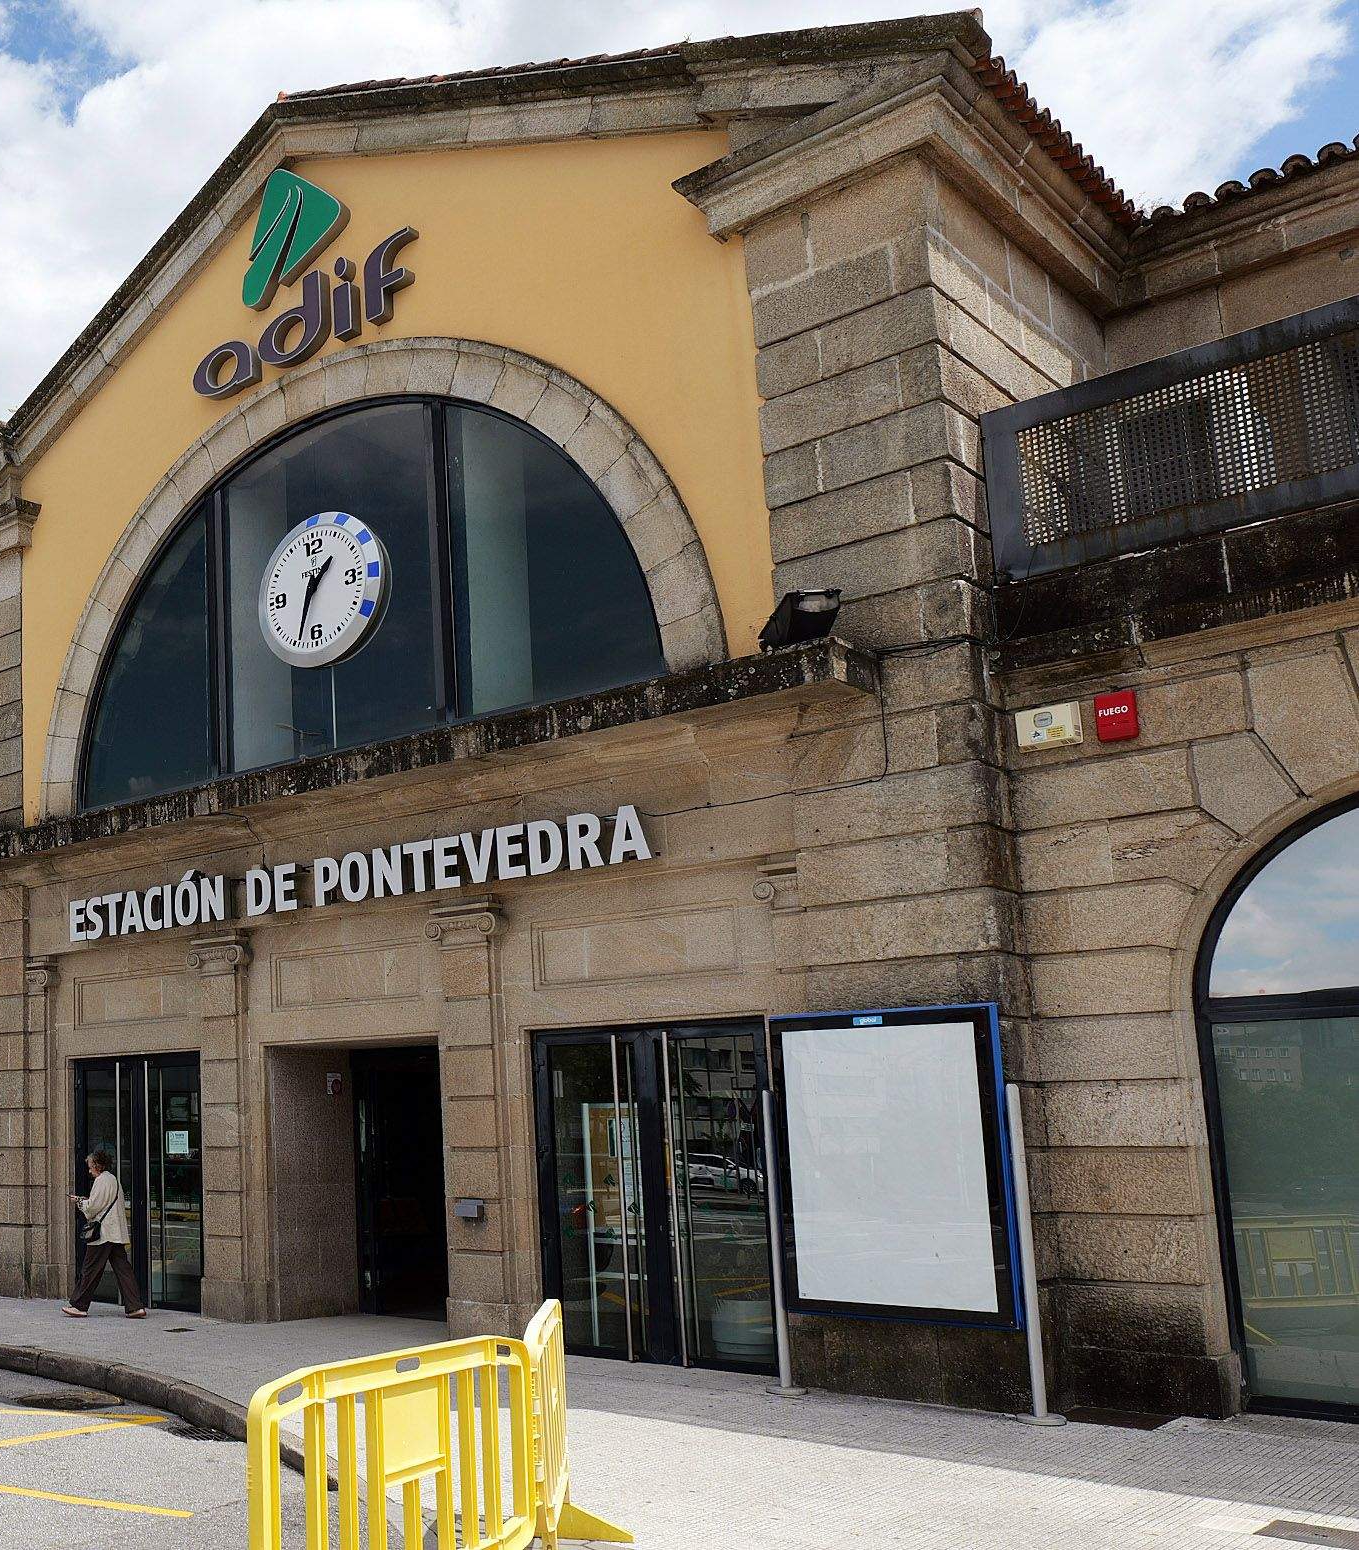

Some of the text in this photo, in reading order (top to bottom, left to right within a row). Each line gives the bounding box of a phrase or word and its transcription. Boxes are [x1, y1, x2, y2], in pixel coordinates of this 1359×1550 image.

[193, 226, 418, 399] adif
[303, 538, 323, 557] 12
[344, 568, 357, 585] 3
[275, 593, 287, 609] 9
[310, 624, 323, 640] 6
[1098, 705, 1129, 717] FUEGO
[68, 805, 653, 942] ESTACIÓN DE PONTEVEDRA
